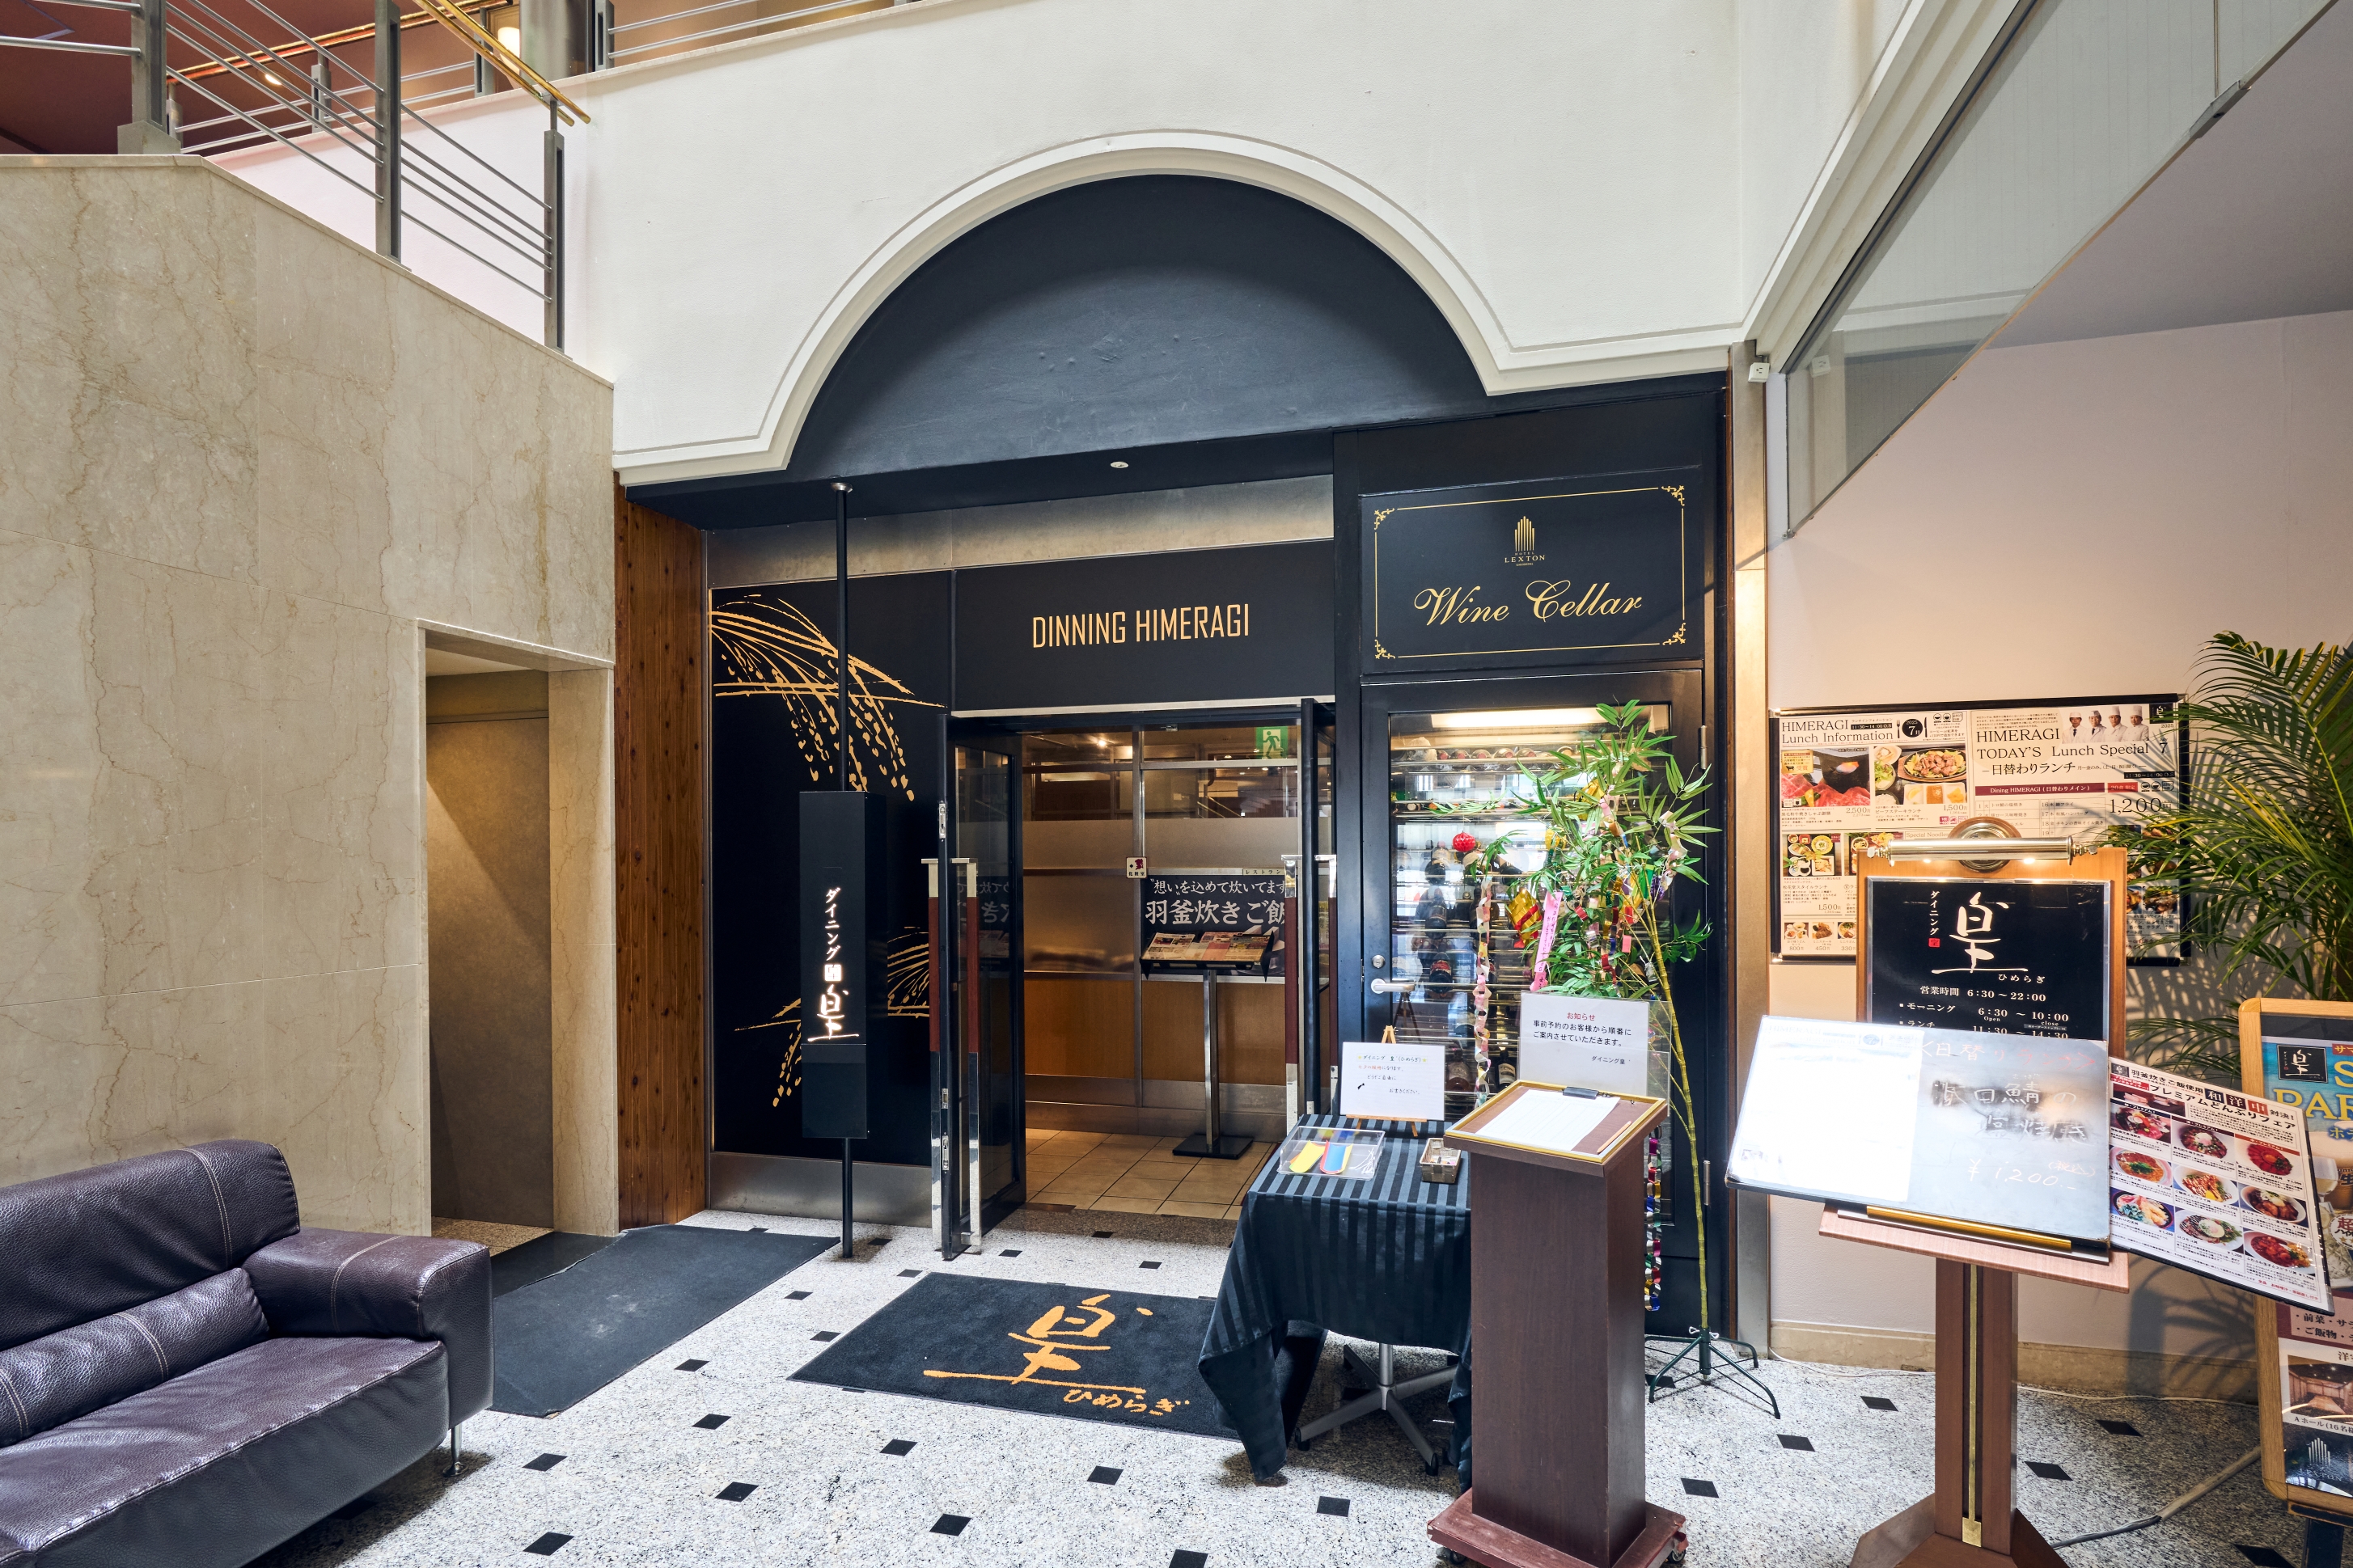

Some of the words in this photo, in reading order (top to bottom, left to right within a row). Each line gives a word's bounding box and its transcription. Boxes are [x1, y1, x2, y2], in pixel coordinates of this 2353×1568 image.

[1504, 555, 1545, 563] LEXTON
[1414, 585, 1509, 626] Wine
[1526, 580, 1642, 623] Cellar
[1033, 611, 1126, 648] DINNING
[1136, 603, 1249, 642] HIMERAGI
[1782, 720, 1848, 732] HIMERAGI
[1782, 733, 1818, 744] Lunch
[1823, 731, 1894, 742] Information
[1977, 728, 2060, 742] HIMERAGI
[1977, 746, 2042, 759] TODAY'S
[2052, 745, 2094, 757] Lunch
[2100, 743, 2148, 756] Special
[2159, 742, 2168, 754] 7
[1992, 762, 2076, 775] 日替わりランチ
[1145, 899, 1284, 924] 羽釜炊きご飯
[1929, 890, 1940, 936] ダイニング
[825, 887, 841, 961] ダイニング
[1998, 974, 2046, 984] ひめらぎ
[1920, 986, 1959, 996] 営業時間
[1567, 1012, 1596, 1021] お知らせ
[1907, 1003, 1956, 1013] モーニング
[1978, 1008, 2008, 1017] 6:30
[2031, 1012, 2069, 1022] 10:00
[1534, 1020, 1631, 1036] 事前予約のお客様から順番に
[1534, 1031, 1622, 1046] ご案内させていただきます。
[2131, 1069, 2203, 1094] 羽釜炊きご飯使用
[2150, 1084, 2296, 1129] プレミアムどんぶりフェア
[1064, 1388, 1189, 1416] ひめらぎ
